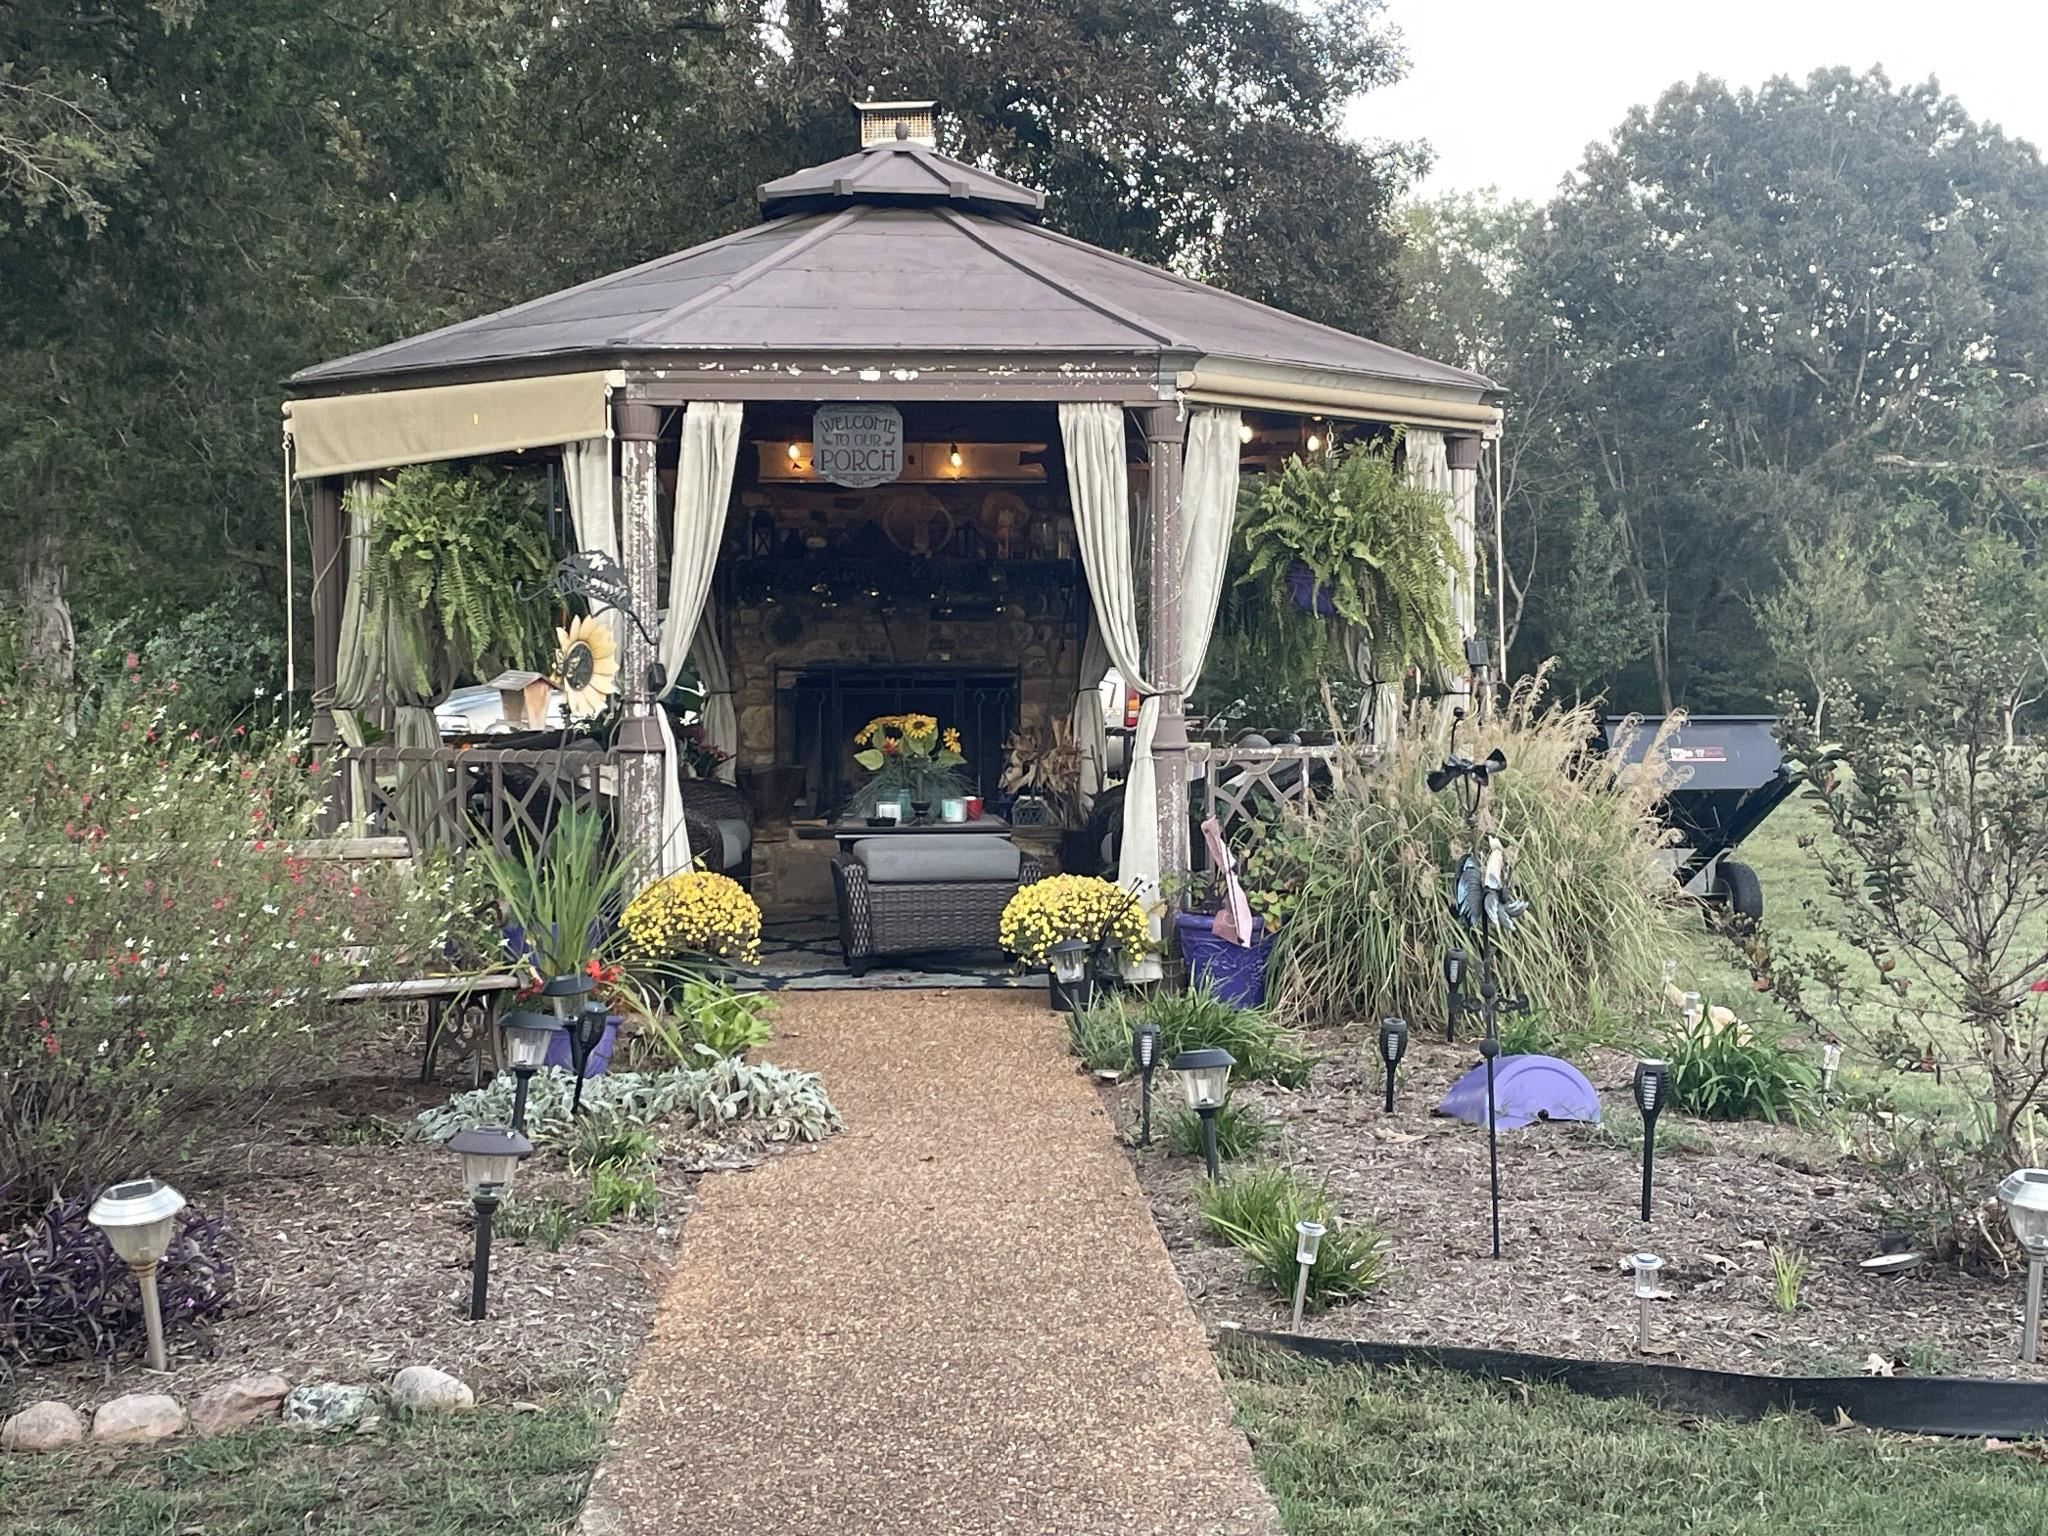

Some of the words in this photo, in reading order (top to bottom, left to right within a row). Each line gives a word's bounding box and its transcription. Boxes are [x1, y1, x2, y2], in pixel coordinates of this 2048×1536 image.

[820, 415, 896, 434] WELCOME
[833, 433, 850, 446] TO
[854, 433, 882, 446] OUR
[821, 449, 896, 471] PORCH
